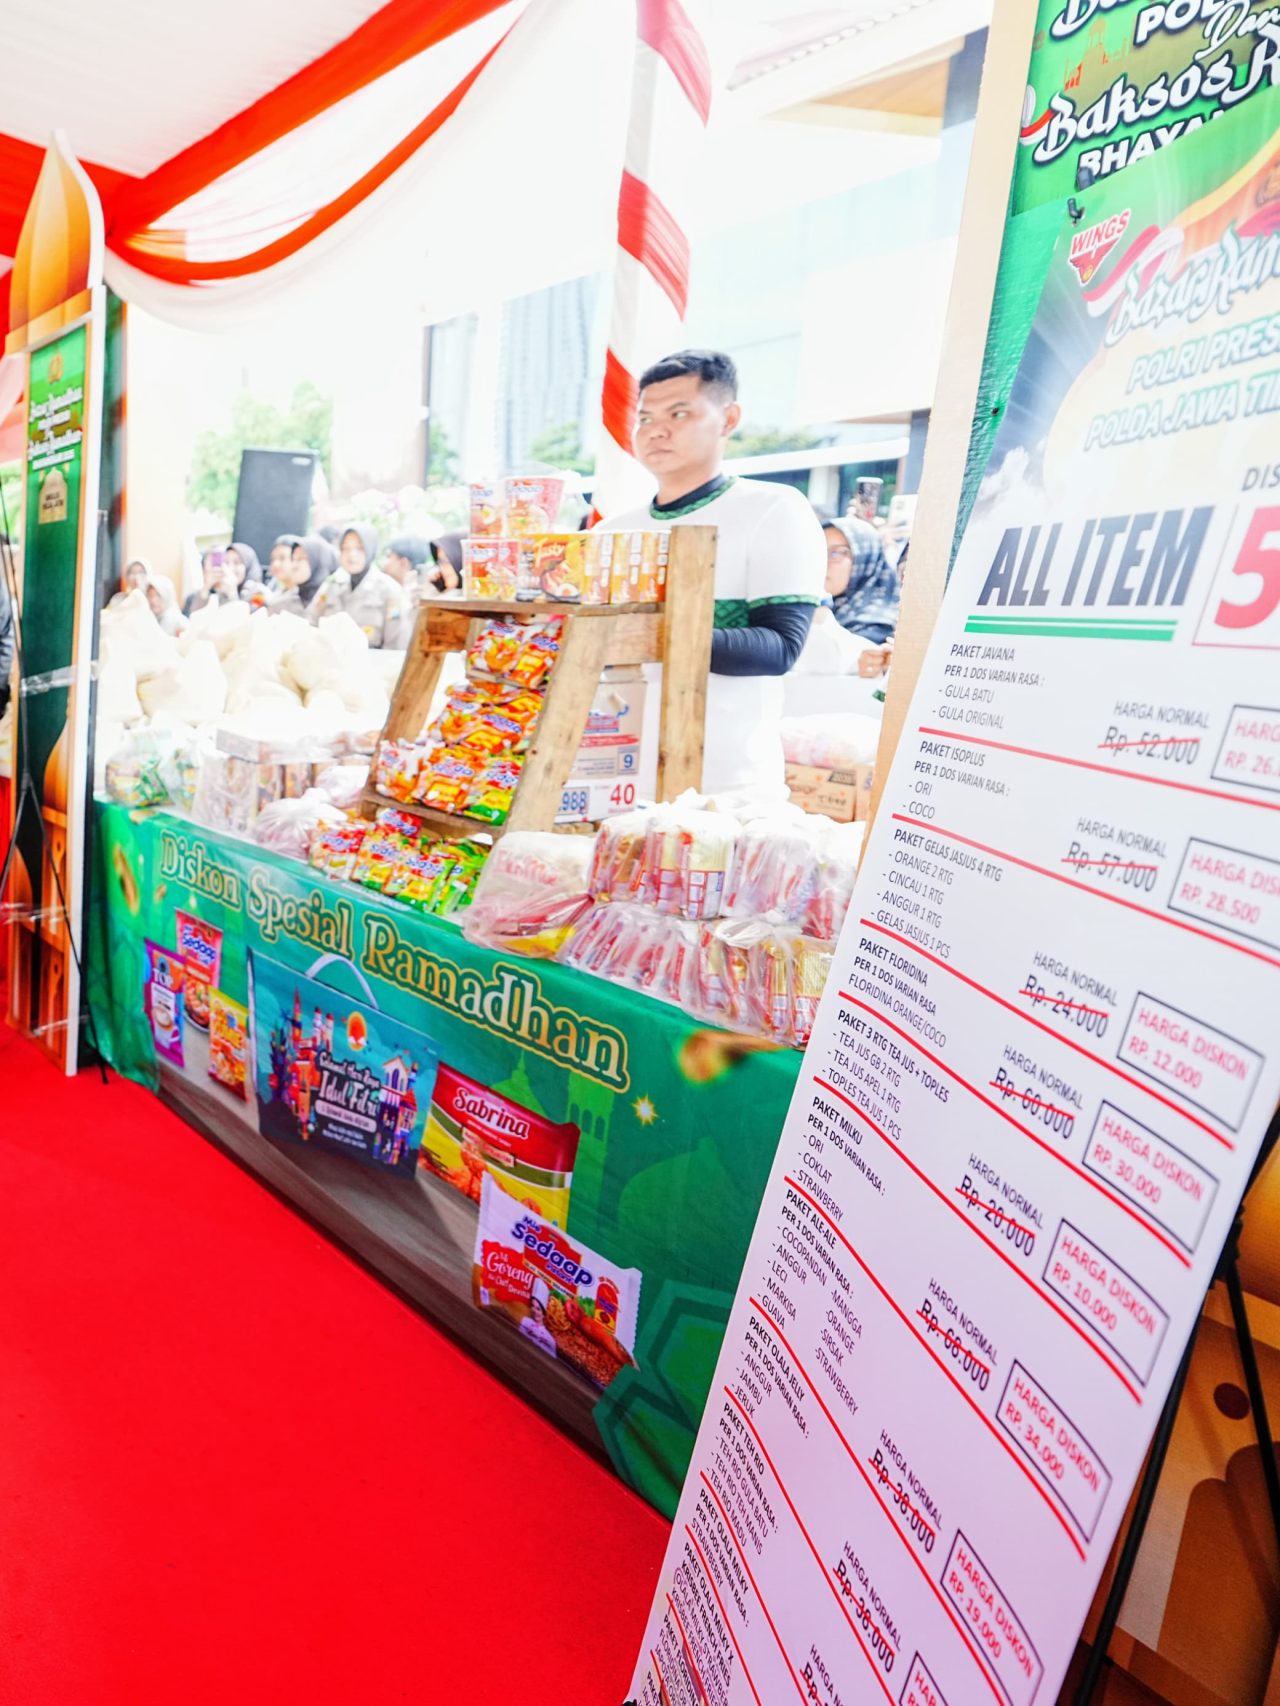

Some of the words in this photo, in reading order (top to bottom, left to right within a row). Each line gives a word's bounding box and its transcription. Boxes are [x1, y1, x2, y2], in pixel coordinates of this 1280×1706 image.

[1033, 53, 1234, 163] Baksos
[1071, 209, 1131, 254] WINGS
[1126, 336, 1206, 395] POLRI
[1084, 399, 1162, 452] POLDA
[1162, 380, 1240, 434] JAWA
[976, 522, 1063, 606] ALL
[1061, 505, 1216, 606] ITEM
[945, 665, 962, 676] PER
[963, 666, 969, 678] 1
[970, 667, 987, 680] DOS
[989, 670, 1018, 683] VARIAN
[1018, 675, 1039, 687] RASA
[951, 644, 981, 658] PAKET
[982, 647, 1016, 661] JAVANA
[939, 706, 963, 721] GULA
[965, 710, 1004, 729] ORIGINAL
[945, 685, 970, 699] GULA
[972, 688, 994, 703] BATU
[1114, 701, 1155, 720] HARGA
[1157, 708, 1210, 729] NORMAL
[623, 754, 633, 768] 9
[920, 741, 951, 760] PAKET
[951, 748, 986, 767] ISOPLUS
[610, 783, 635, 805] 40
[909, 801, 935, 819] COCO
[915, 781, 933, 796] ORI
[894, 829, 925, 848] PAKET
[925, 839, 950, 860] GELAS
[950, 848, 978, 871] JASJUS
[978, 861, 983, 873] 4
[984, 863, 1003, 882] RTG
[1077, 817, 1114, 839] HARGA
[1119, 831, 1168, 859] NORMAL
[894, 851, 932, 878] ORANGE
[932, 865, 938, 878] 2
[938, 867, 954, 885] RTG
[1190, 854, 1245, 884] HARGA
[160, 831, 241, 908] Diskon
[247, 869, 354, 961] Spesial
[363, 912, 630, 1091] Ramadhan
[859, 938, 889, 961] PAKET
[889, 953, 928, 987] FLORIDINA
[1033, 951, 1069, 976] HARGA
[1071, 968, 1119, 1007] NORMAL
[849, 974, 892, 1008] FLORIDINA
[893, 1000, 947, 1048] ORANGE/COCO
[838, 1010, 867, 1035] PAKET
[866, 1028, 872, 1038] 3
[872, 1030, 888, 1051] RTG
[888, 1040, 902, 1060] TEA
[901, 1053, 915, 1074] JUS
[920, 1070, 950, 1103] TOPLES
[1137, 1007, 1190, 1048] HARGA
[1193, 1036, 1249, 1081] DISKON
[1003, 1045, 1037, 1076] HARGA
[1039, 1067, 1084, 1111] NORMAL
[454, 1088, 529, 1138] Sabrina
[812, 1097, 840, 1123] PAKET
[840, 1117, 863, 1145] MILKU
[803, 1152, 833, 1184] COKLAT
[808, 1134, 824, 1153] ORI
[1102, 1117, 1150, 1159] HARGA
[1153, 1152, 1205, 1202] DISKON
[797, 1169, 844, 1222] STRAWBERRY
[968, 1152, 1002, 1186] HARGA
[1002, 1183, 1044, 1229] NORMAL
[786, 1189, 812, 1218] PAKET
[811, 1213, 837, 1250] ALE-ALE
[487, 1252, 535, 1289] Goreng
[511, 1222, 593, 1286] Sedaap
[772, 1260, 788, 1283] LECI
[776, 1244, 808, 1284] ANGGUR
[782, 1227, 828, 1287] COCOPANDAN
[767, 1277, 797, 1321] MARKISA
[1061, 1235, 1108, 1288] HARGA
[1109, 1278, 1157, 1336] DISKON
[762, 1295, 785, 1330] GUAVA
[928, 1277, 959, 1322] HARGA
[959, 1312, 999, 1366] NORMAL
[744, 1354, 772, 1398] ANGGUR
[749, 1316, 772, 1348] PAKET
[772, 1345, 791, 1379] OLALA
[788, 1373, 806, 1402] JELLY
[735, 1386, 756, 1418] JERUK
[739, 1369, 762, 1405] JAMBU
[724, 1402, 745, 1436] PAKET
[744, 1432, 756, 1452] TEH
[753, 1451, 765, 1475] RIO
[1013, 1377, 1057, 1429] HARGA
[1057, 1427, 1102, 1491] DISKON
[880, 1428, 908, 1476] HARGA
[908, 1470, 943, 1531] NORMAL
[843, 1540, 869, 1589] HARGA
[868, 1587, 902, 1653] NORMAL
[956, 1548, 995, 1611] HARGA
[995, 1607, 1034, 1680] DISKON
